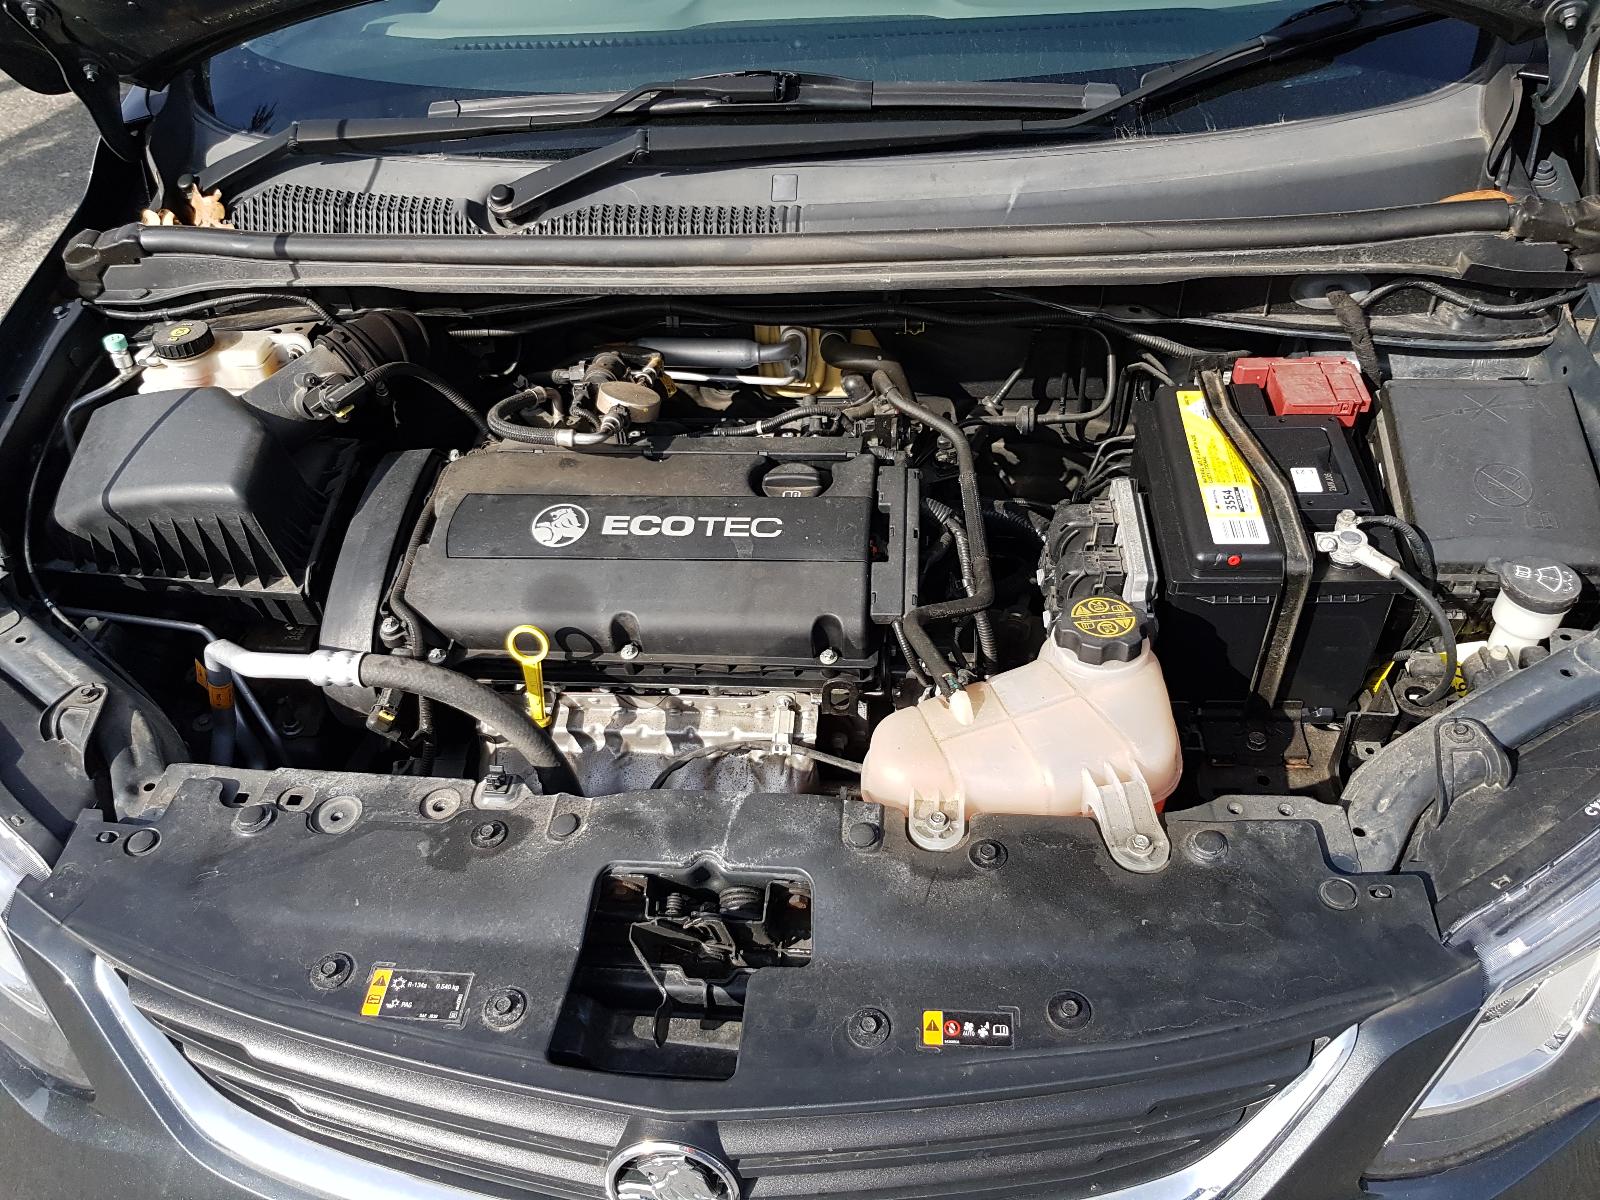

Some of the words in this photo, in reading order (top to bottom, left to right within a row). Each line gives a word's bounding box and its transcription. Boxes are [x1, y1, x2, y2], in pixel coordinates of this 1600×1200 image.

[1222, 489, 1238, 511] 3554
[601, 515, 783, 538] ECOTEC
[407, 981, 428, 990] R-134a
[400, 1001, 413, 1009] PAG
